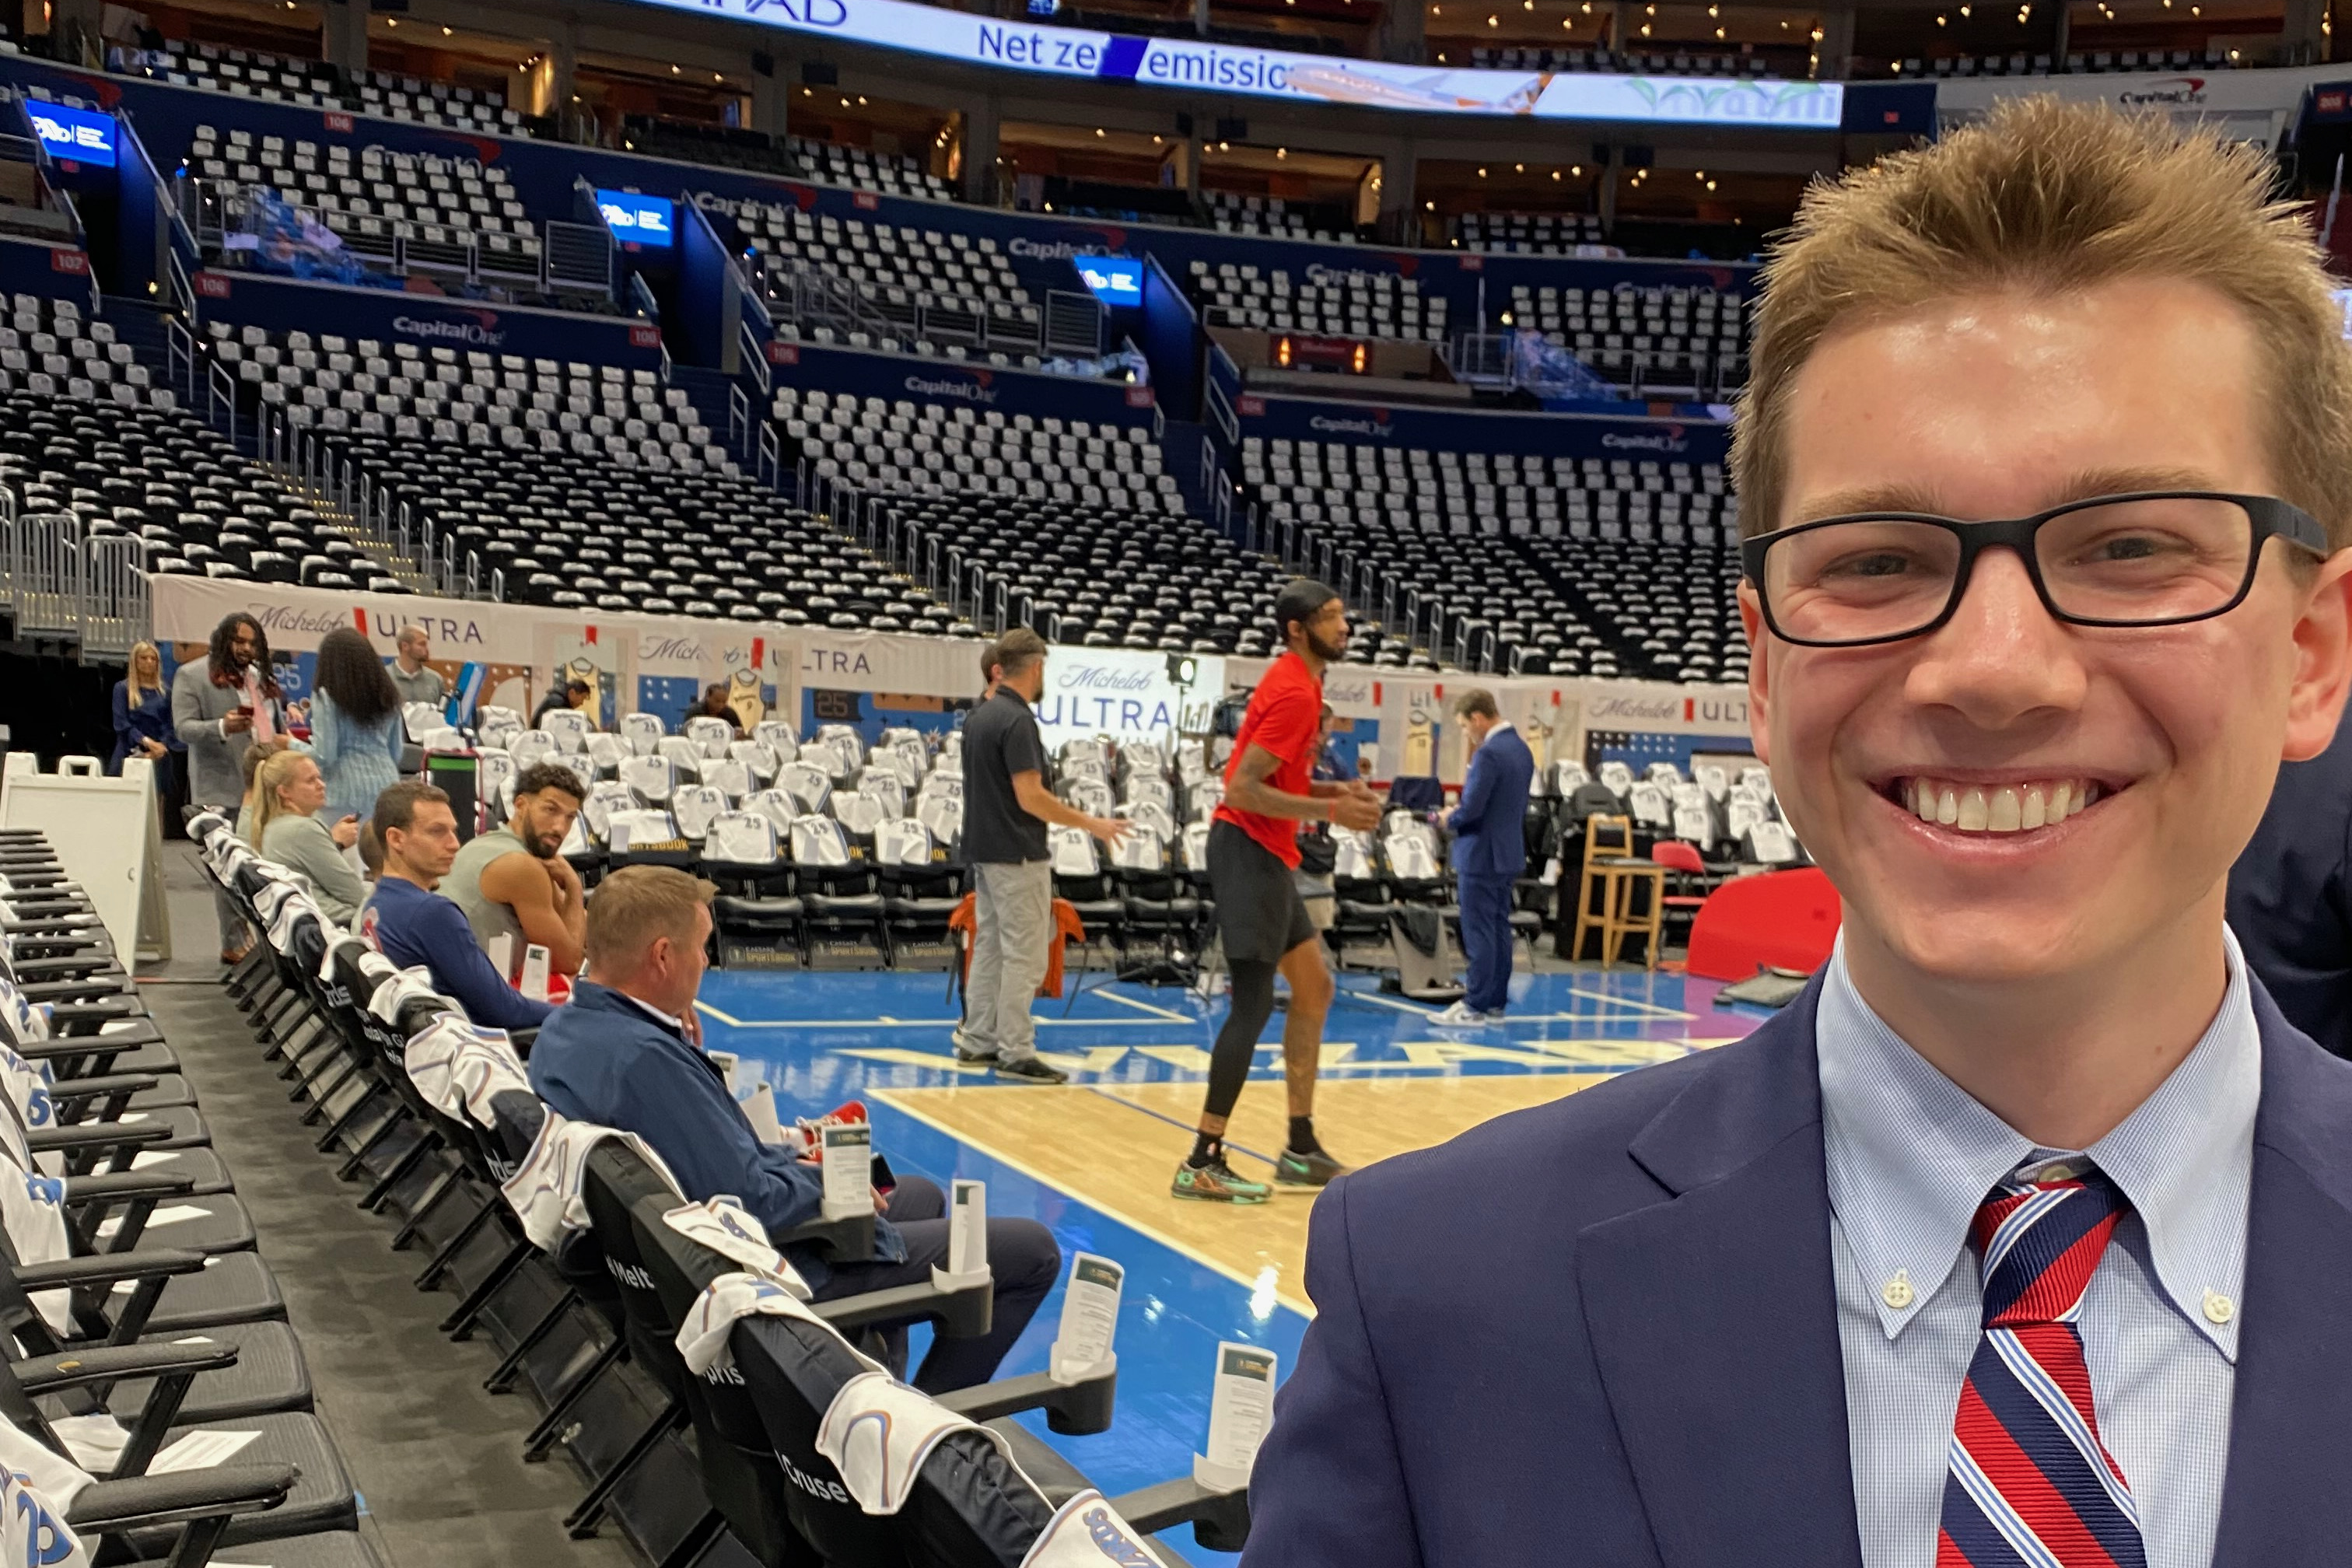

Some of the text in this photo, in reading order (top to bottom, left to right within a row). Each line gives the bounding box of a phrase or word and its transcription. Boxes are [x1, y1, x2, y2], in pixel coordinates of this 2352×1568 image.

[978, 23, 1044, 65] Net
[1055, 39, 1108, 72] ze
[376, 614, 483, 644] UTRA
[1058, 664, 1156, 691] Michelob
[1038, 695, 1172, 732] ULTRA
[1702, 702, 1748, 722] ULT
[781, 1453, 849, 1504] Cruse
